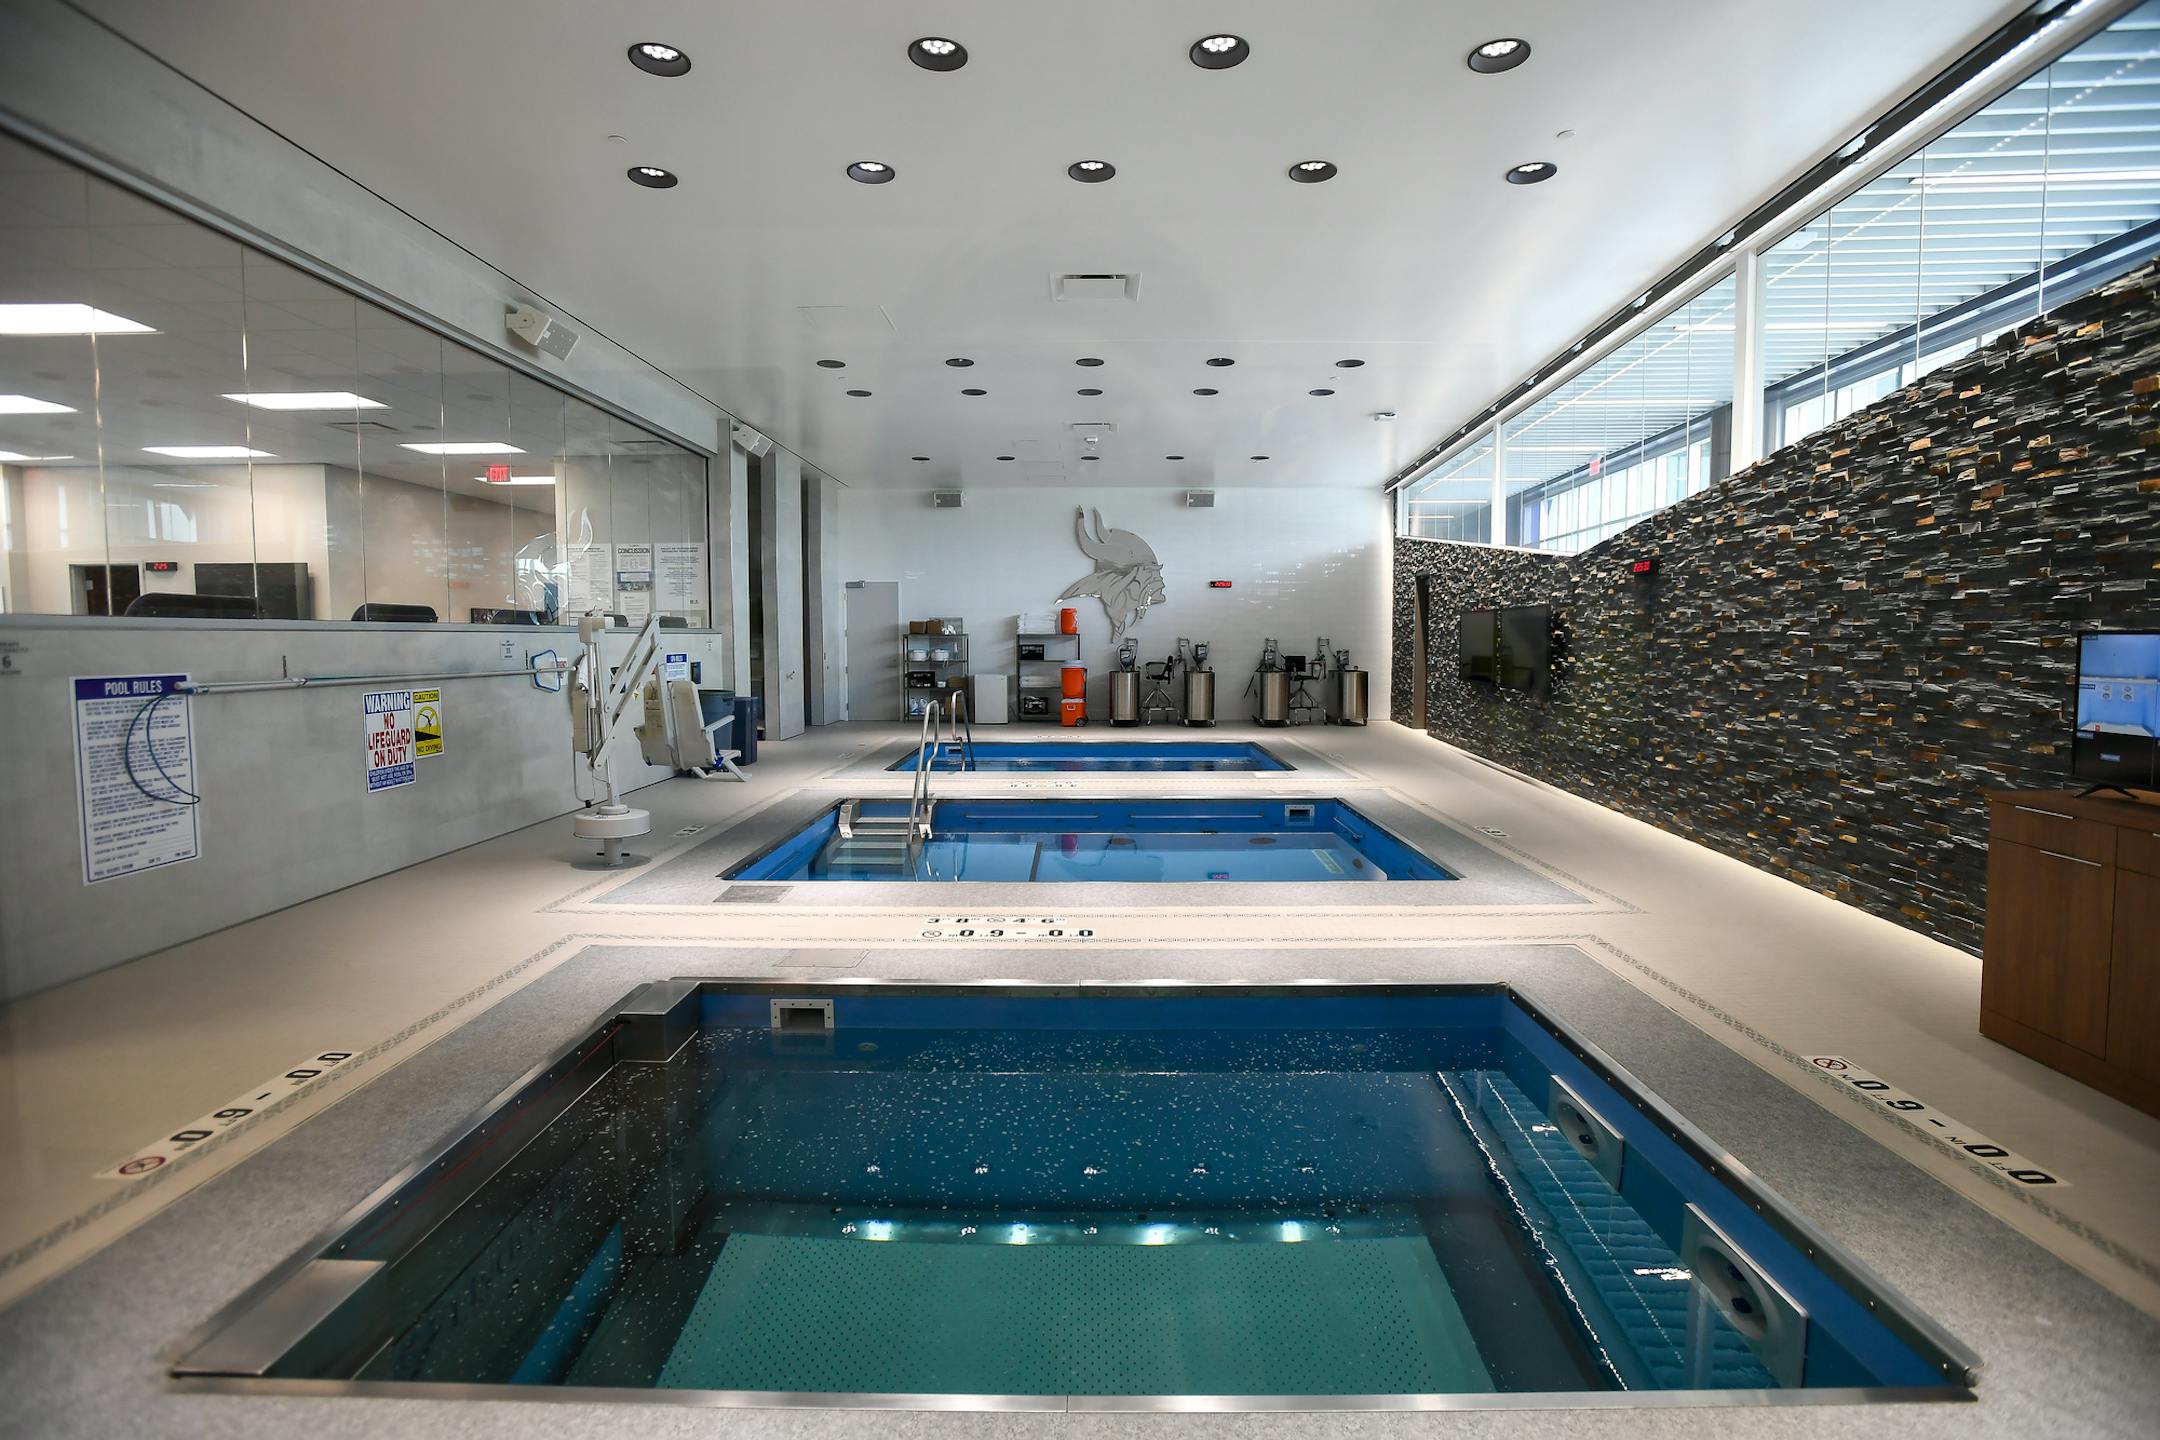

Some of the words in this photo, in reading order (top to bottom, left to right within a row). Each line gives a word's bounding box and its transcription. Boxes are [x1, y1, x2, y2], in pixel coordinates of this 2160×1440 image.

[105, 681, 130, 695] POOL
[133, 680, 163, 694] RULES
[414, 691, 439, 700] CAUTION
[365, 692, 410, 713] WARNING
[383, 712, 395, 729] NO
[368, 728, 411, 750] LIFEGUARD
[374, 749, 386, 767] ON
[388, 746, 407, 765] DUTY
